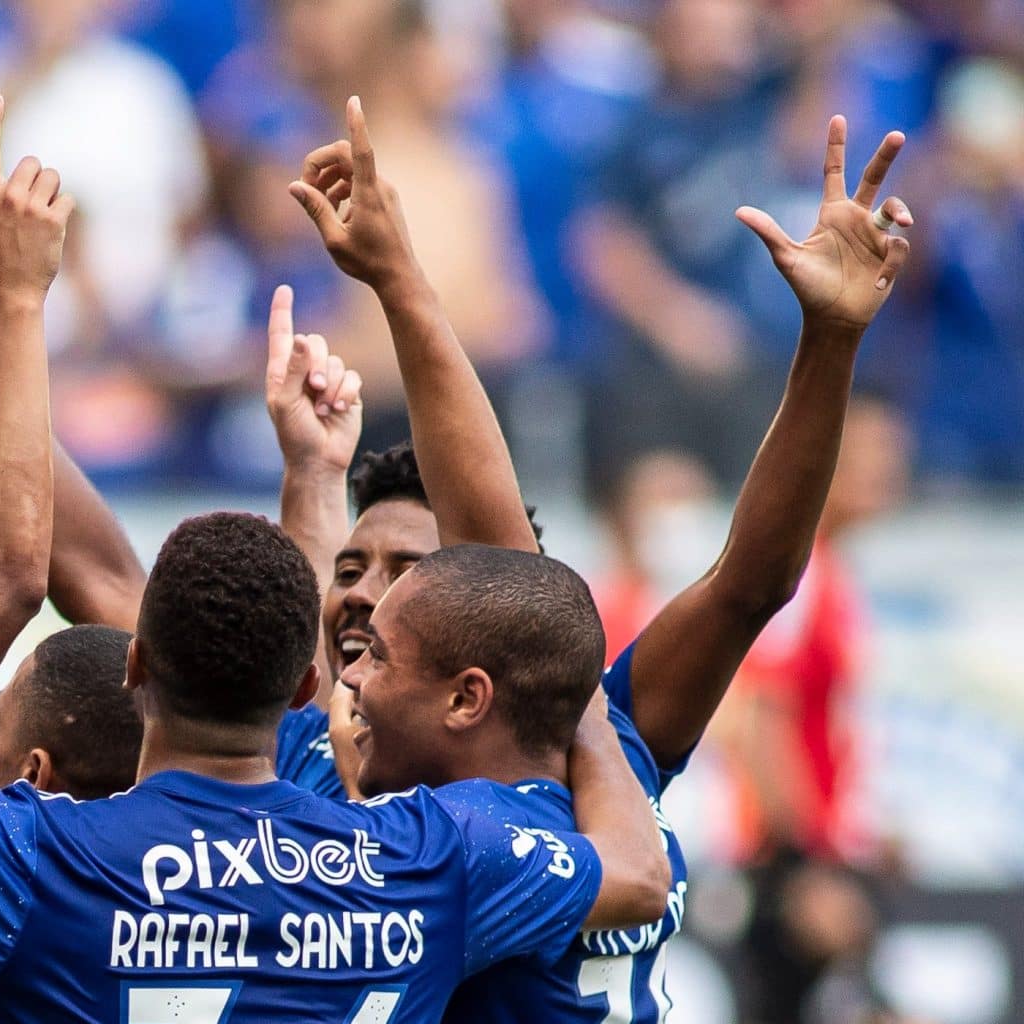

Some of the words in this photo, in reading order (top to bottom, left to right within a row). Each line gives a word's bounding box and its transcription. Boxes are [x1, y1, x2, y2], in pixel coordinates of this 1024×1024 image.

[142, 819, 385, 906] pixbet
[110, 910, 259, 969] RAFAEL
[275, 908, 425, 969] SANTOS
